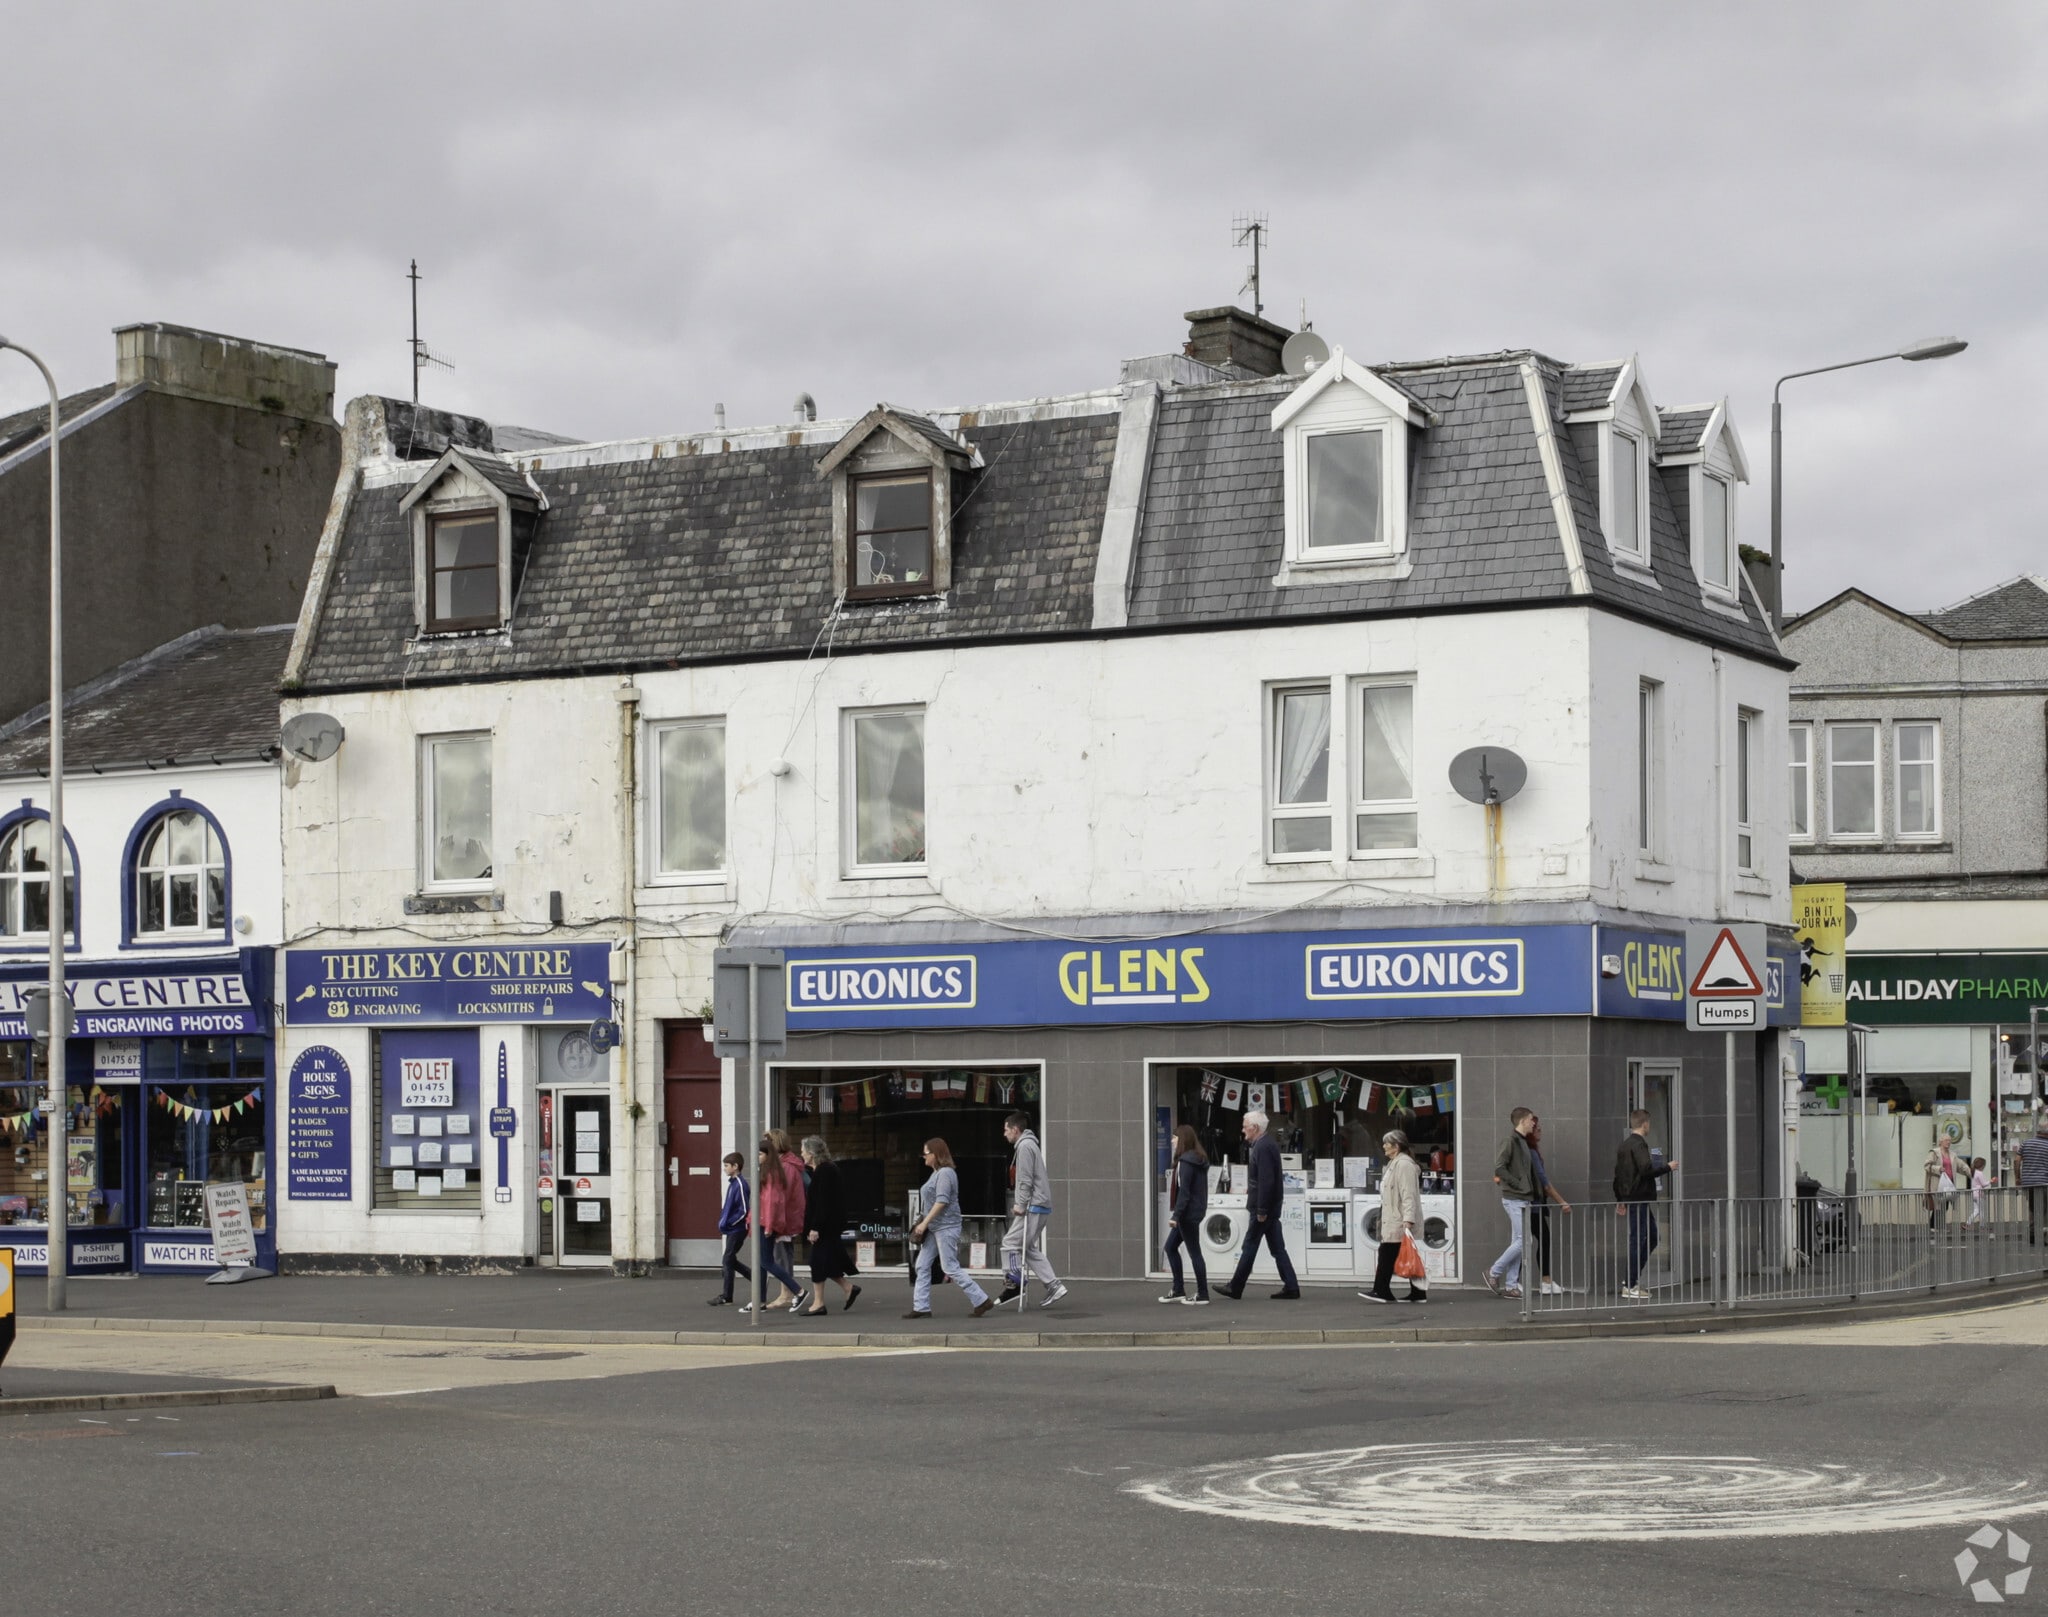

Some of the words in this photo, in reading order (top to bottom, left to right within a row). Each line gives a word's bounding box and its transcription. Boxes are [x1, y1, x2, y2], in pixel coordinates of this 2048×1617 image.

[1804, 906, 1821, 917] BIN
[1825, 905, 1833, 917] IT
[1824, 916, 1842, 928] WAY
[321, 954, 380, 980] THE
[386, 952, 446, 979] KEY
[452, 950, 572, 977] CENTRE
[1320, 951, 1509, 988] EURONICS
[1624, 941, 1684, 1001] GLENS
[1059, 948, 1210, 1006] GLENS
[490, 984, 522, 995] SHOE
[524, 983, 573, 994] REPAIRS
[800, 966, 963, 1001] EURONICS
[12, 981, 79, 1010] KY
[94, 976, 244, 1007] CENTRE
[321, 986, 345, 998] KEY
[347, 986, 399, 997] CUTTING
[330, 1002, 346, 1015] 91
[354, 1003, 421, 1015] ENGRAVING
[457, 1002, 535, 1014] LOCKSMITHS
[1704, 1007, 1749, 1019] Humps
[87, 1016, 174, 1034] ENGRAVING
[180, 1015, 244, 1031] PHOTOS
[101, 1055, 126, 1065] 01475
[314, 1059, 326, 1070] IN
[303, 1072, 337, 1082] HOUSE
[404, 1062, 422, 1080] TO
[427, 1062, 449, 1080] LET
[304, 1085, 335, 1095] SIGNS
[411, 1083, 445, 1091] 01475
[405, 1095, 426, 1104] 673
[430, 1095, 450, 1104] 673
[694, 1109, 703, 1118] 93
[298, 1129, 334, 1137] TROPHIES
[298, 1140, 311, 1148] PET
[314, 1140, 333, 1148] TAGS
[216, 1189, 236, 1199] Watch
[215, 1198, 240, 1208] Repairs
[222, 1219, 241, 1229] Watch
[219, 1229, 247, 1239] Batteries
[82, 1244, 116, 1253] T-SHIRT
[151, 1247, 196, 1261] WATCH
[77, 1254, 121, 1264] PRINTING
